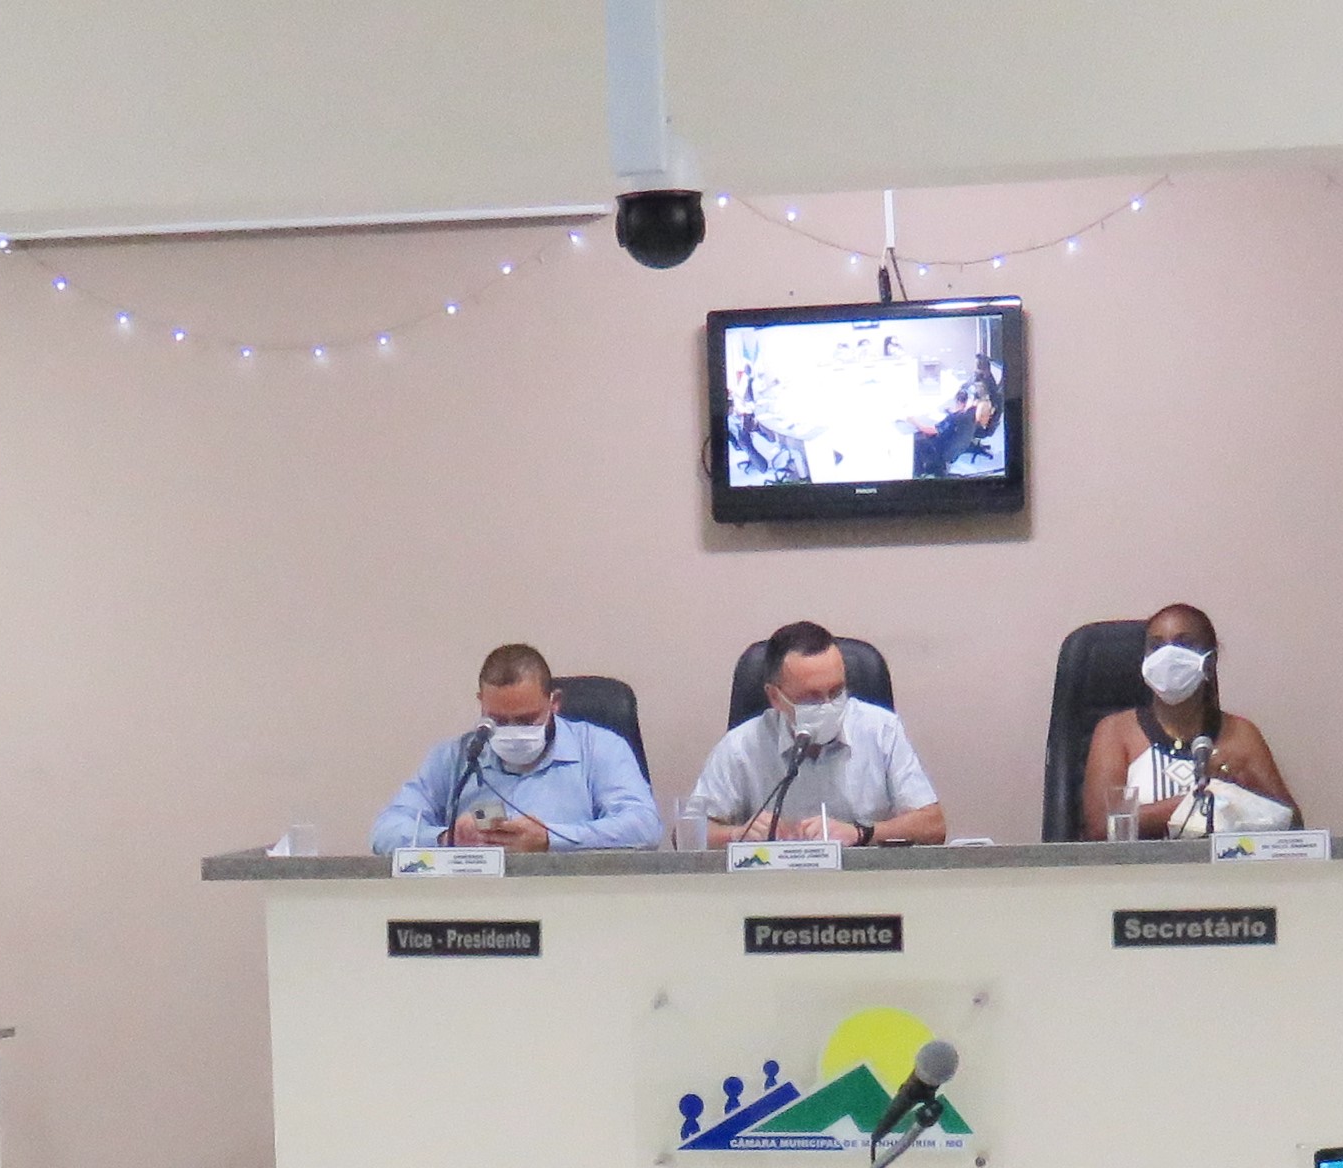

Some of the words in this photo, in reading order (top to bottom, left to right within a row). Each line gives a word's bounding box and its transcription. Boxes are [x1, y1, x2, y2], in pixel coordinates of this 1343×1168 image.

[755, 924, 893, 946] Presidente
[1124, 915, 1267, 939] Secretário
[396, 929, 432, 949] Vice
[447, 928, 531, 949] Presidente
[730, 1137, 777, 1149] CÂMARA
[779, 1138, 840, 1149] MUNICIPAL
